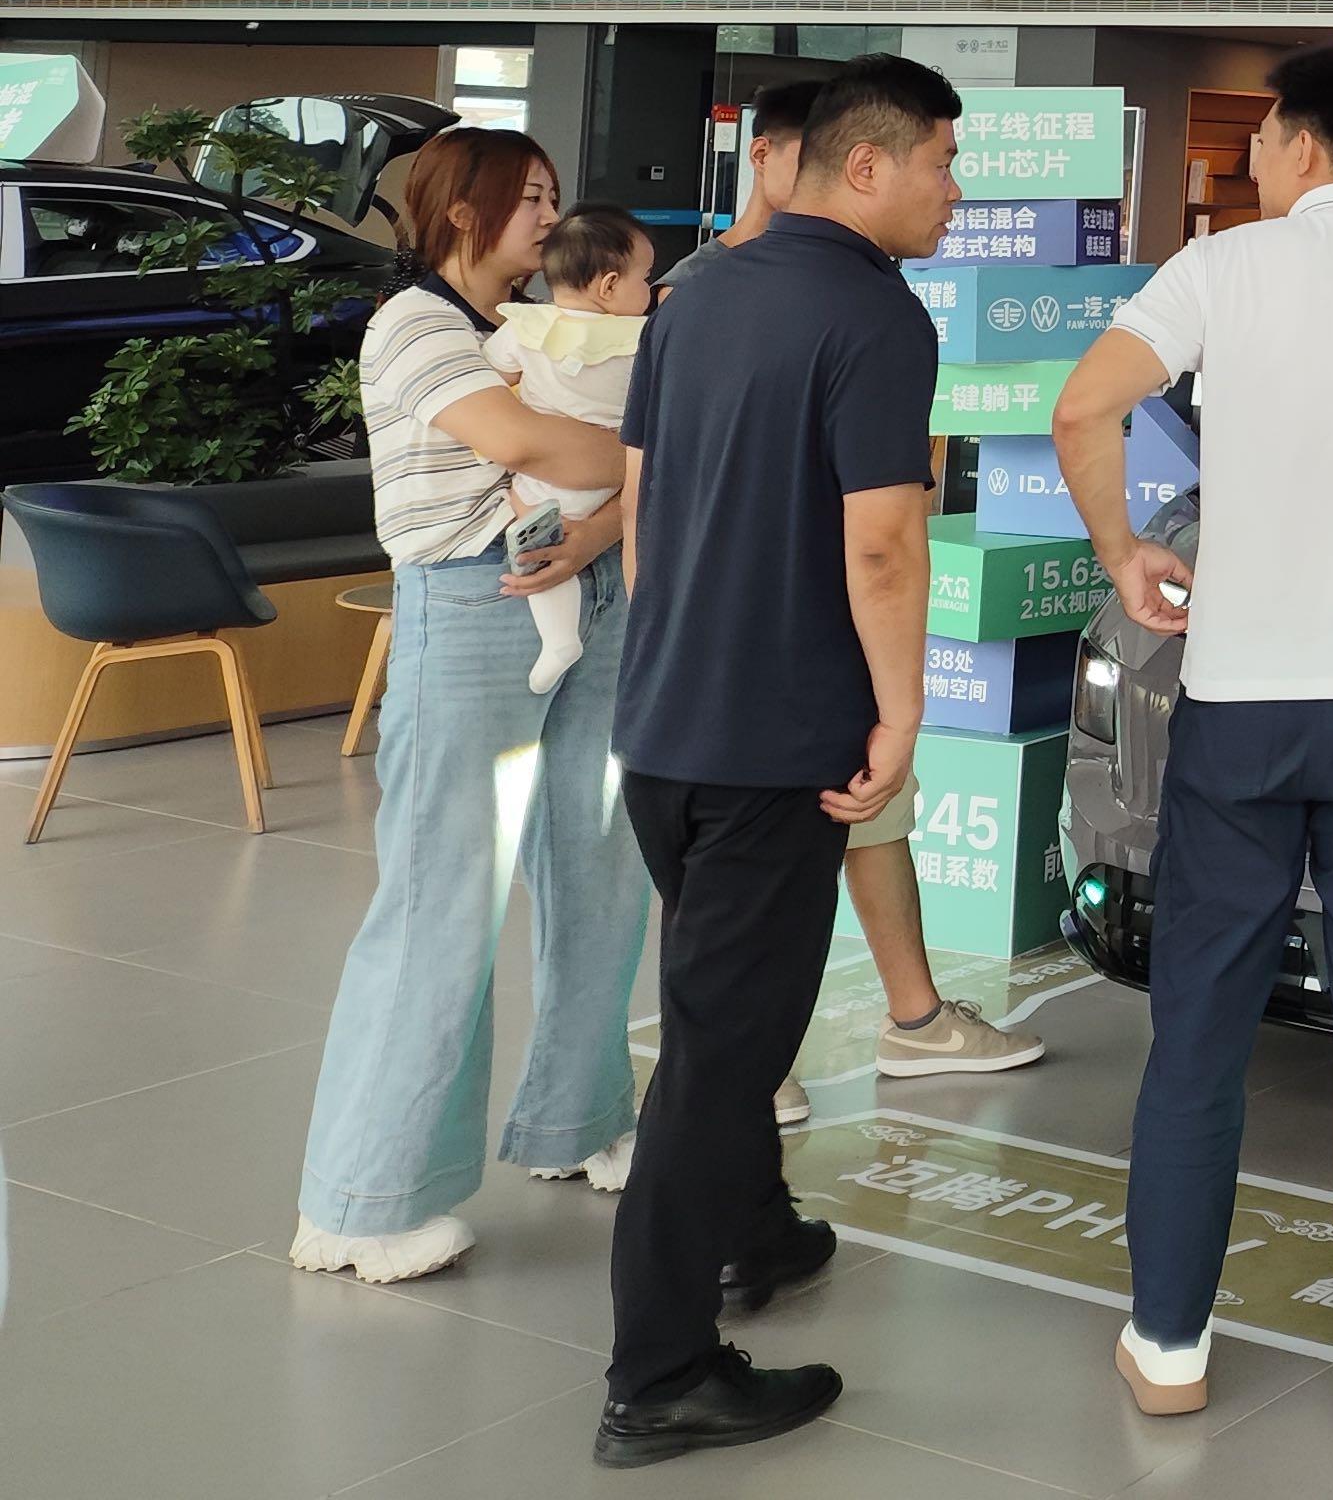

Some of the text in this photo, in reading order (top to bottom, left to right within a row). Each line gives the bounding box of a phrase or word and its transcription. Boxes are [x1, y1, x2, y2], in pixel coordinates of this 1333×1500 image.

[960, 149, 1071, 179] 6H芯片
[942, 235, 1036, 259] 笼式结构
[1138, 482, 1177, 504] T6
[1020, 588, 1112, 620] 2.5K视网
[928, 648, 974, 674] 38处
[916, 851, 999, 892] 阻系数
[837, 1155, 1268, 1256] 迈腾PH
